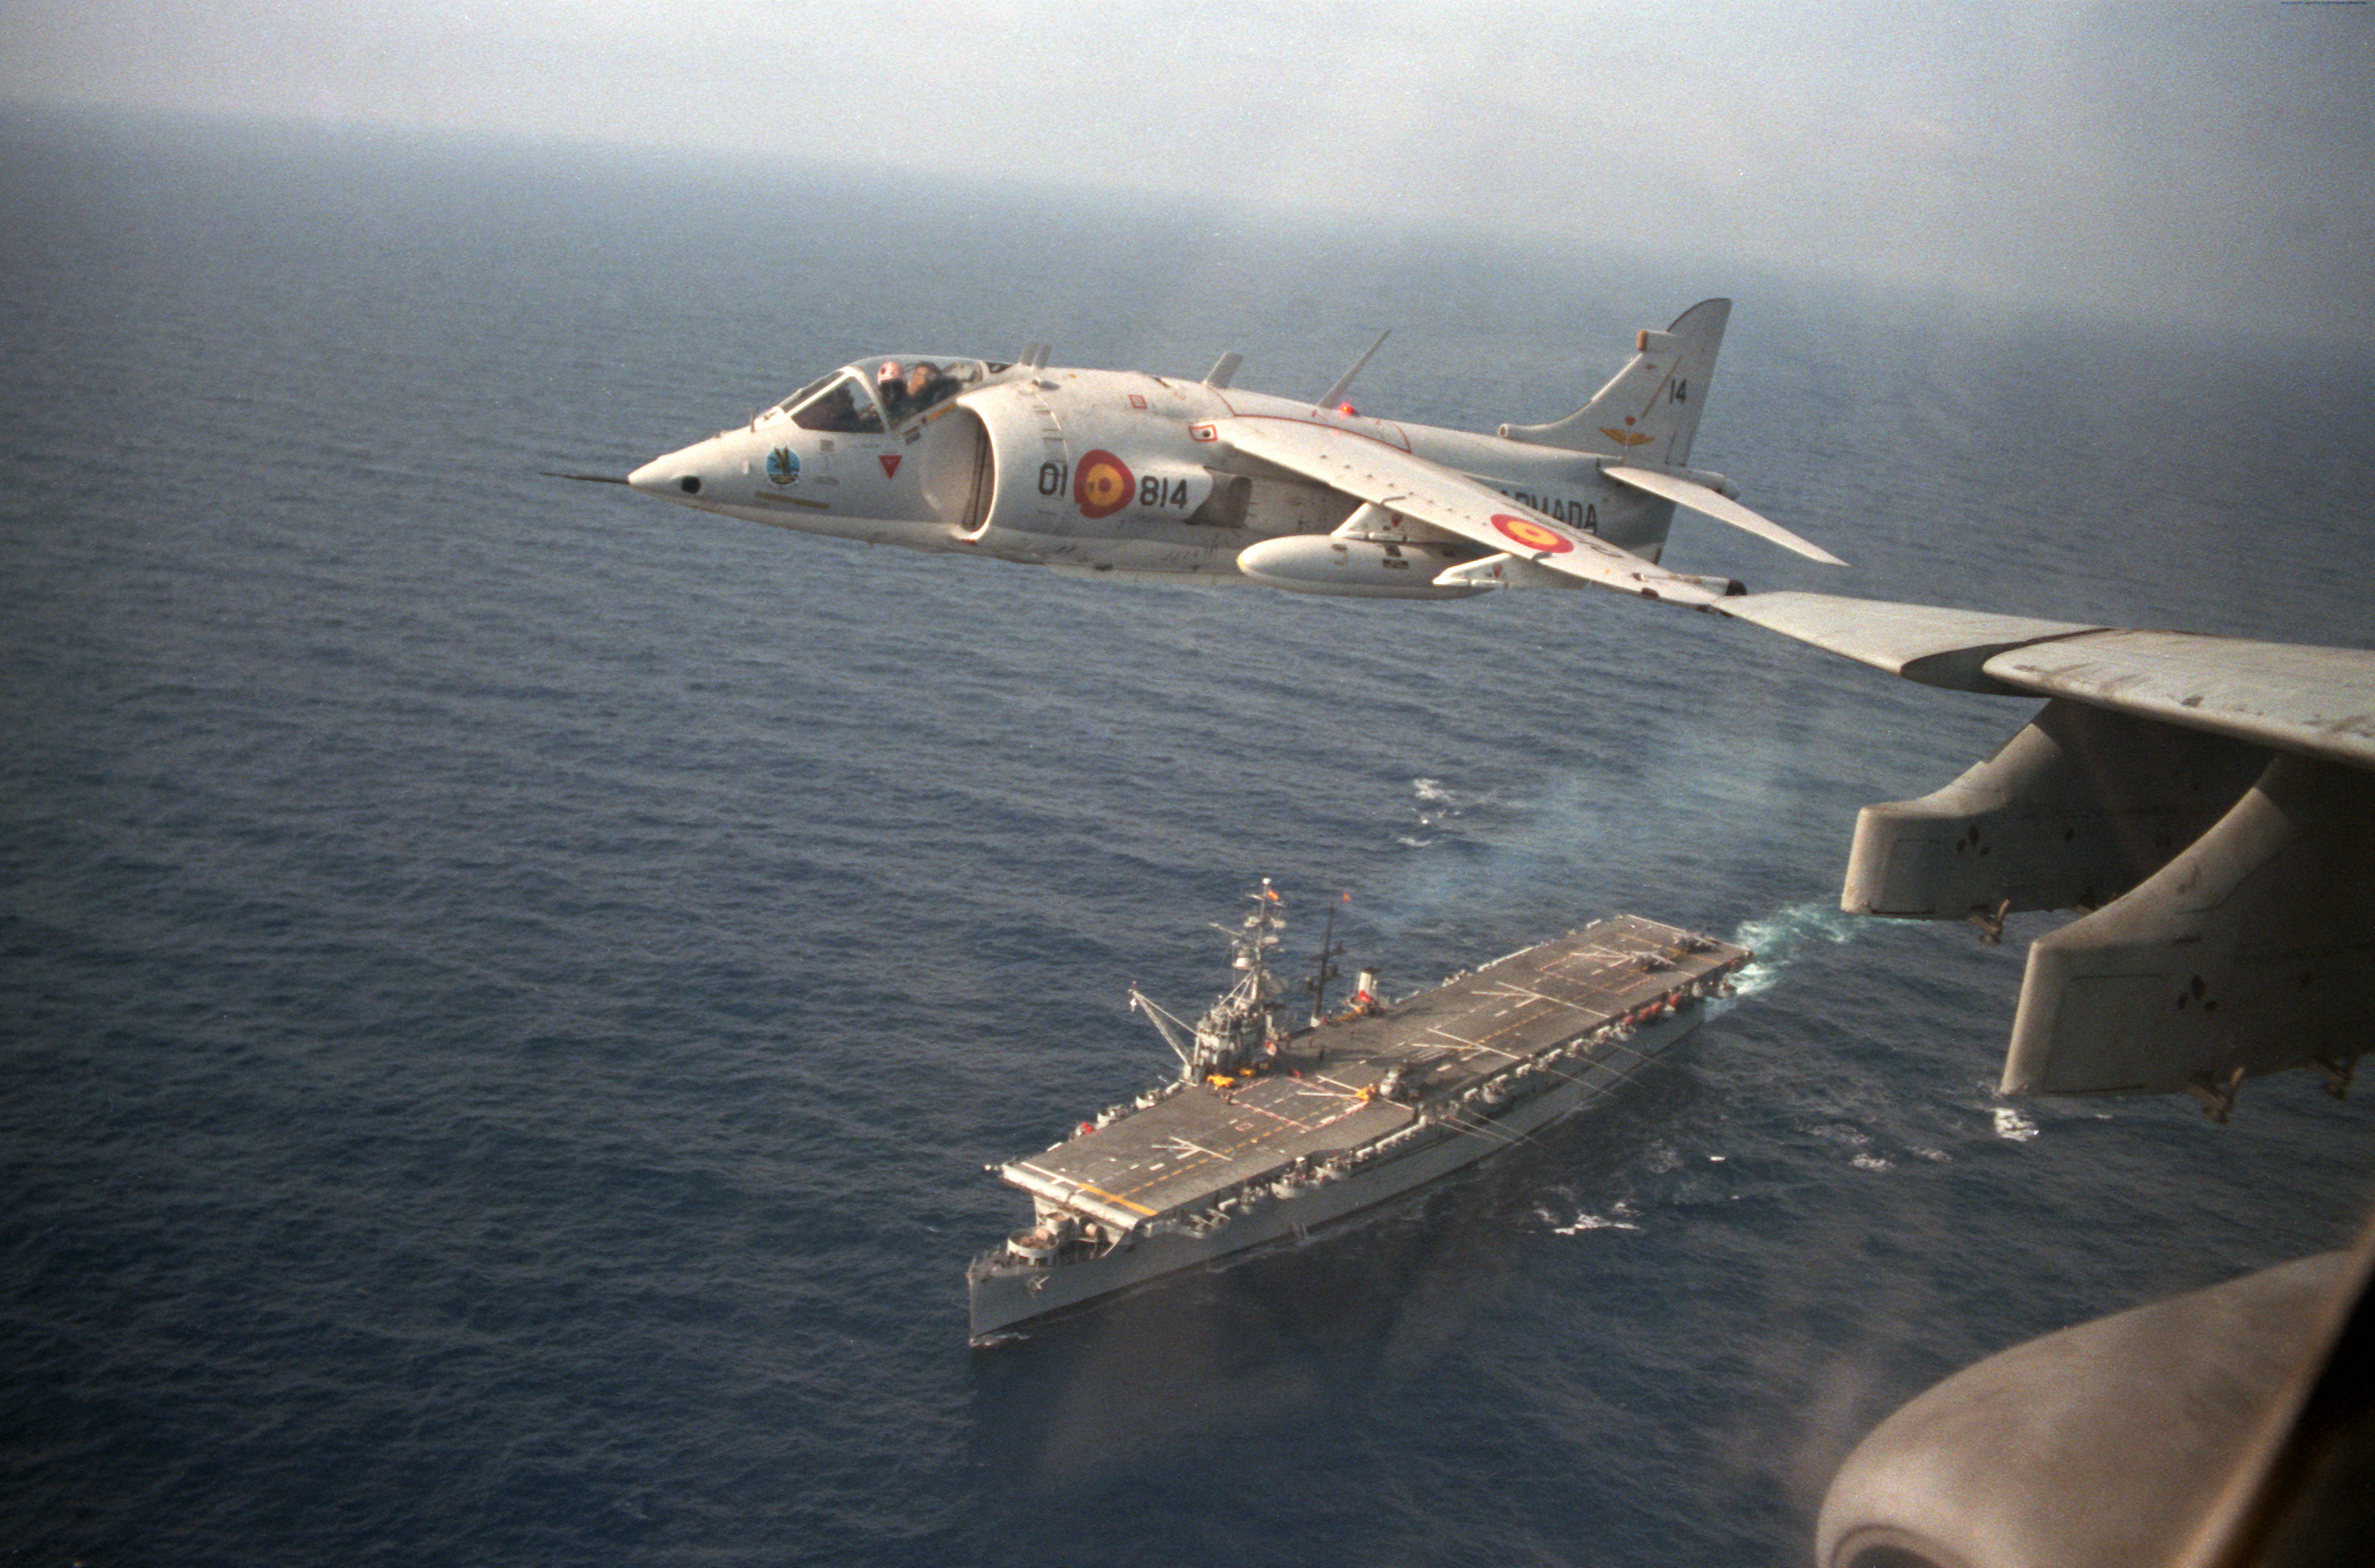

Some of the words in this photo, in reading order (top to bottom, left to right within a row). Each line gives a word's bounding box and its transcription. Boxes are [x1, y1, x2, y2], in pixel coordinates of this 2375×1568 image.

[1669, 377, 1687, 405] 14
[1038, 462, 1068, 497] 01
[1140, 475, 1188, 510] 814
[1500, 489, 1597, 535] MADA
